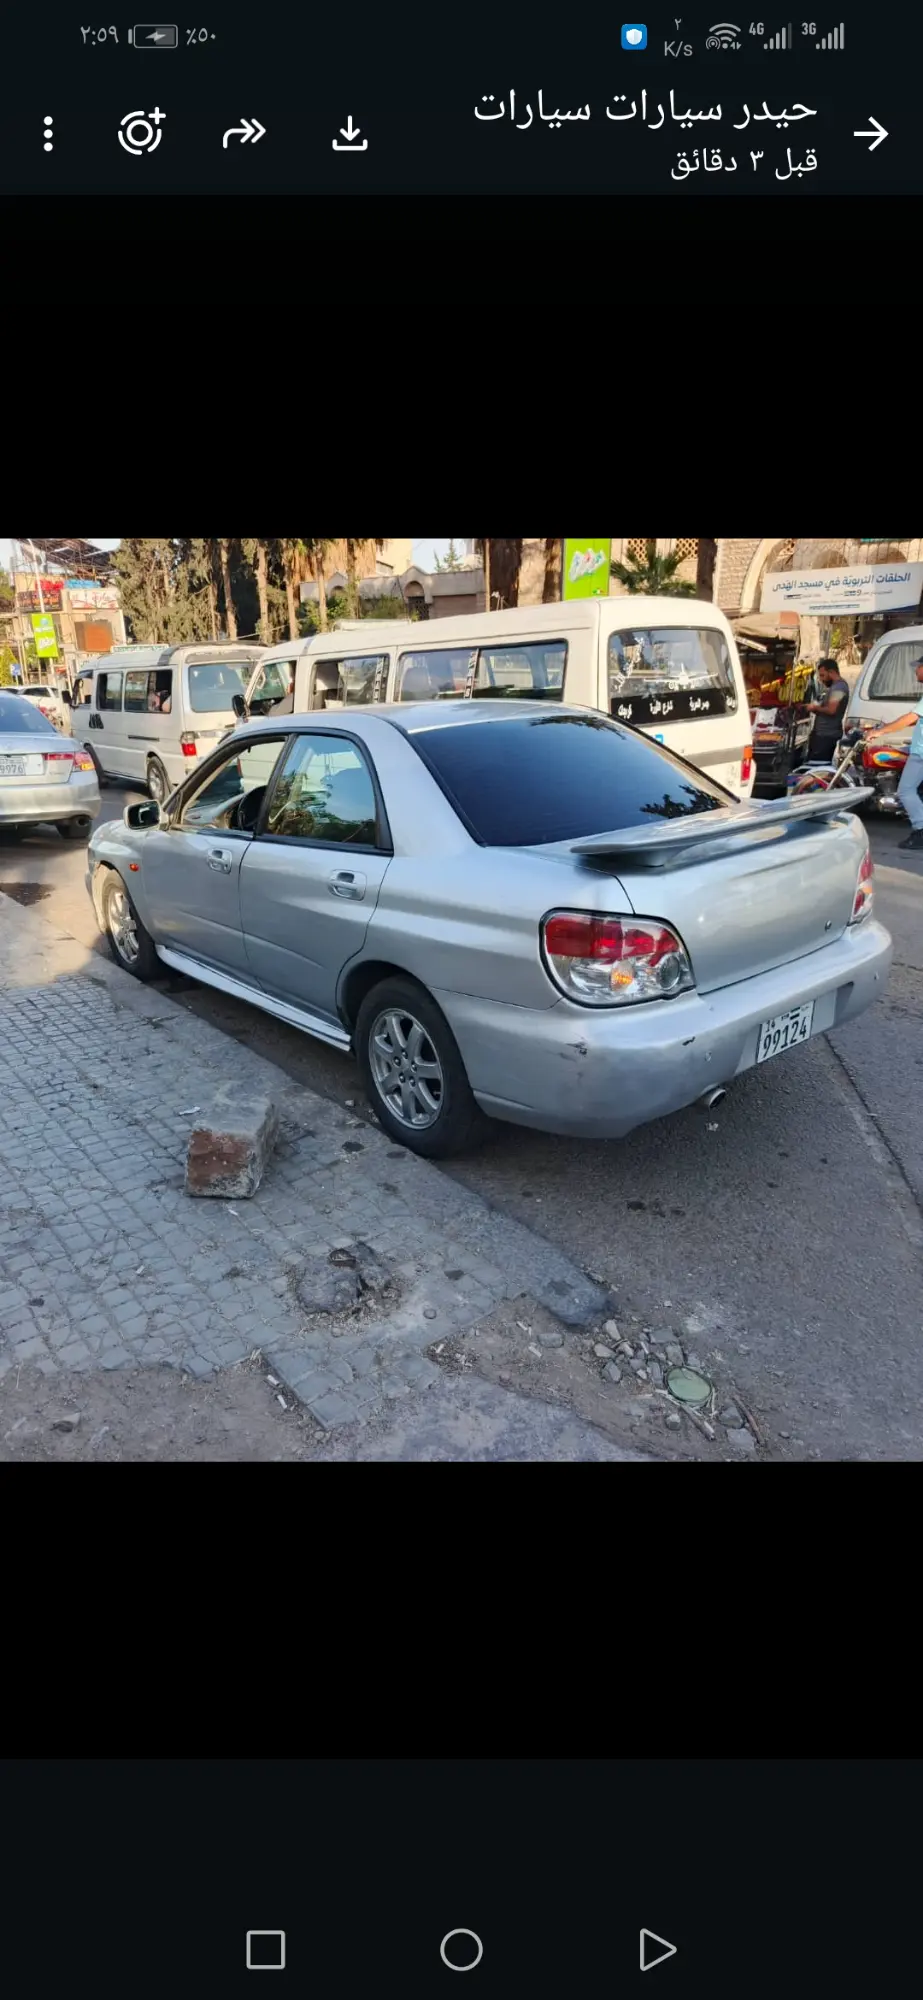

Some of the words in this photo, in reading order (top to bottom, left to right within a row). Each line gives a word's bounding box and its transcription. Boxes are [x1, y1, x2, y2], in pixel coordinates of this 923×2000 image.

[876, 572, 911, 584] الحلقات
[797, 581, 824, 591] مسجد
[824, 579, 841, 591] في
[763, 1016, 808, 1059] 99124
